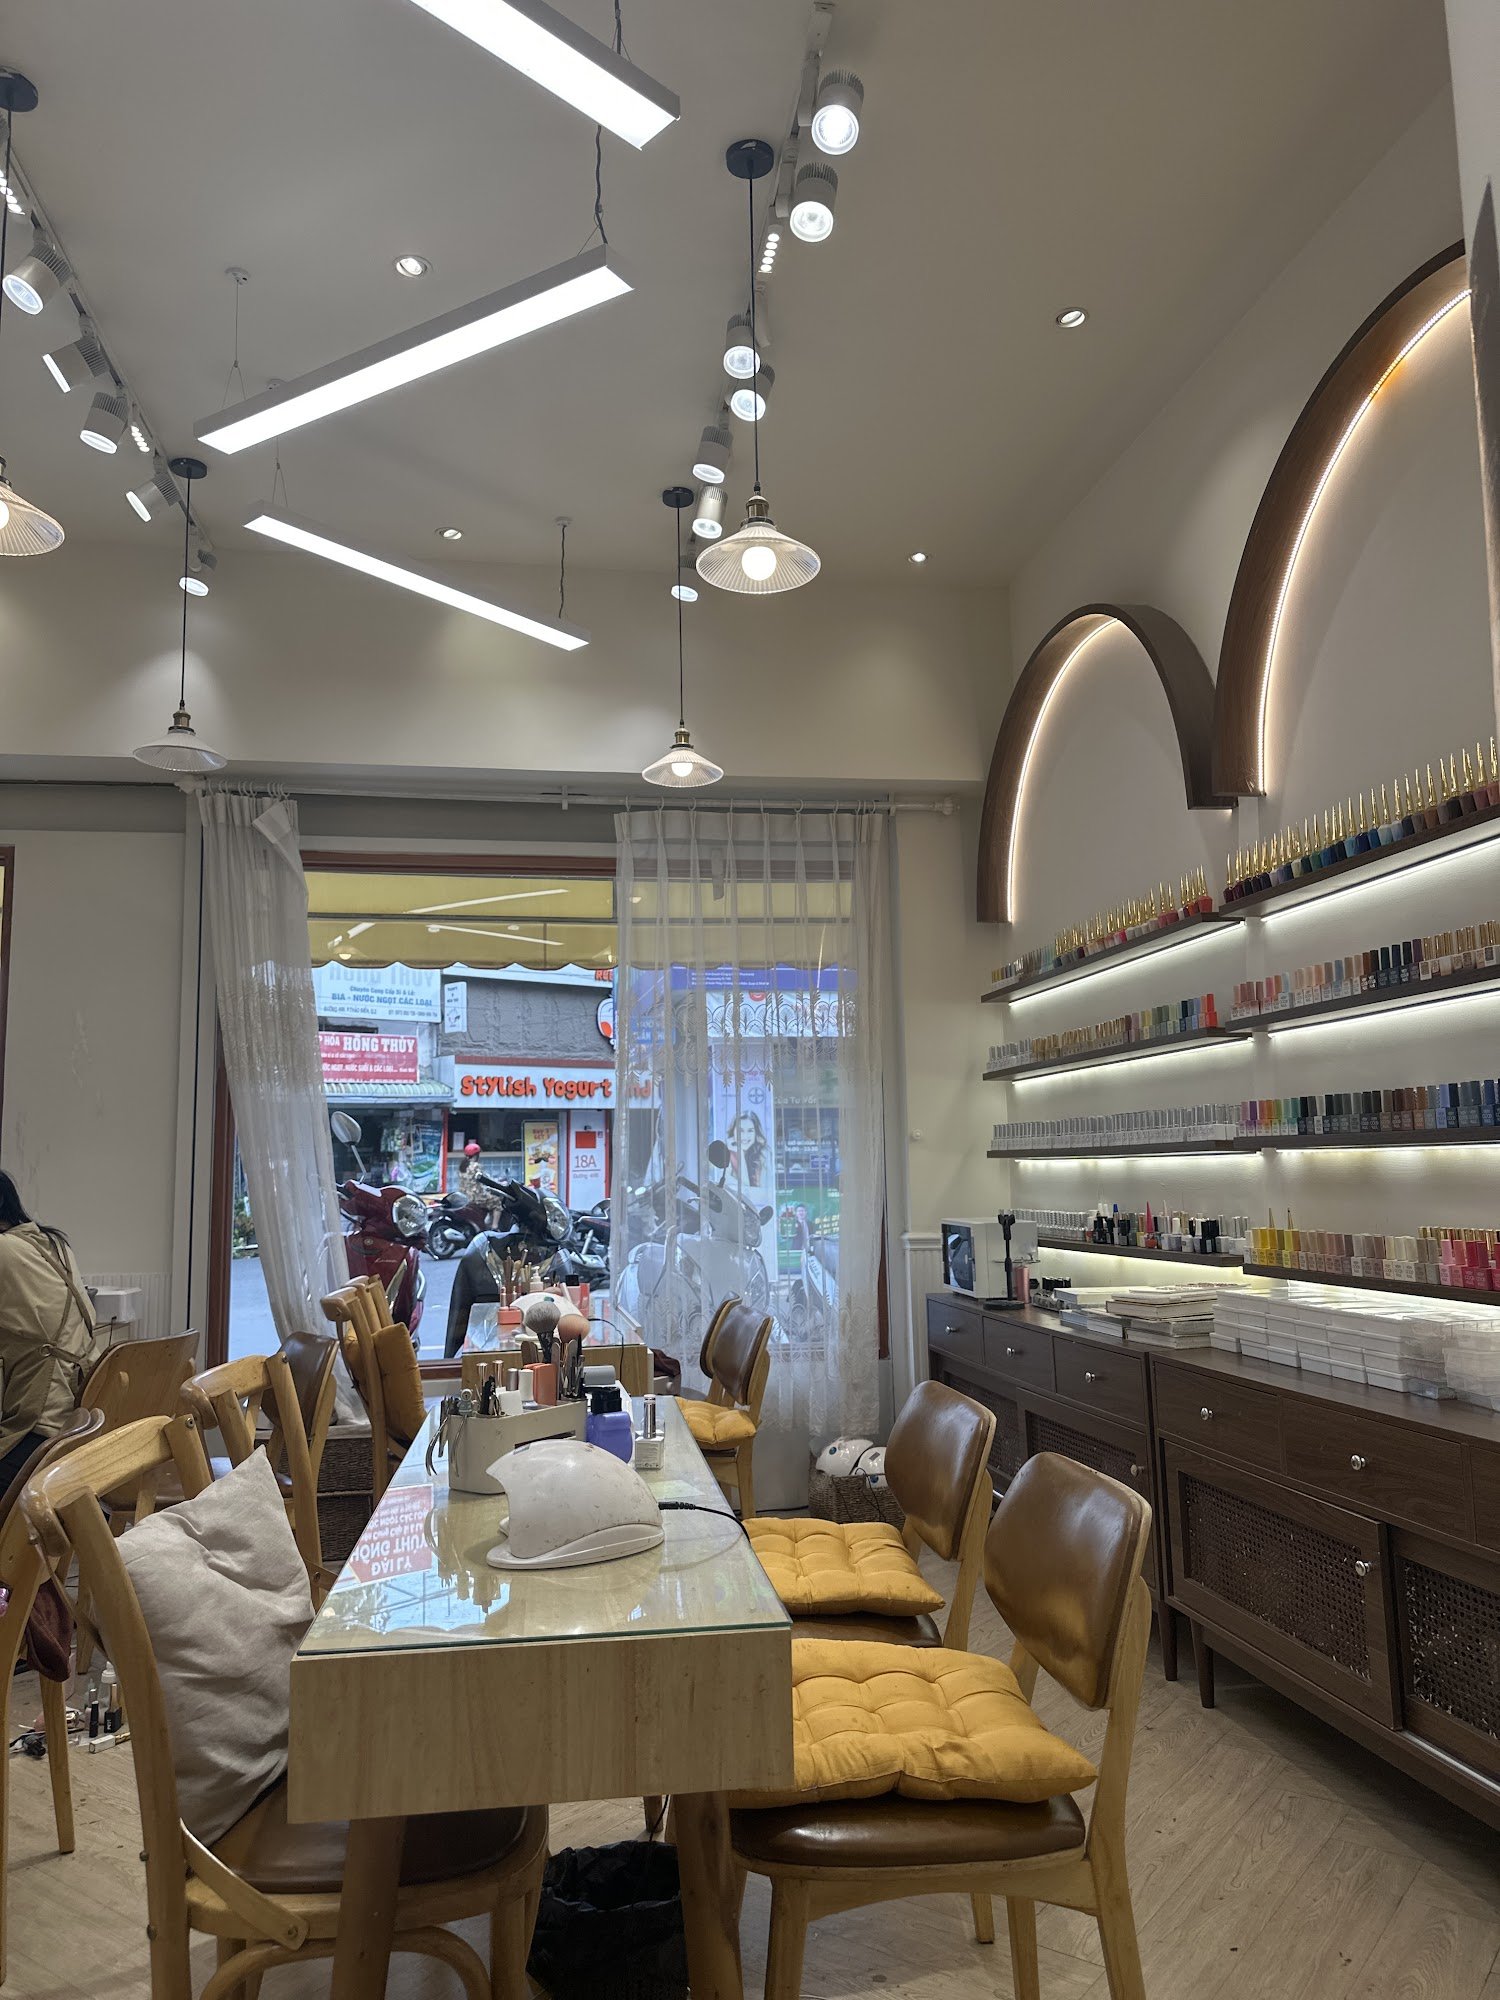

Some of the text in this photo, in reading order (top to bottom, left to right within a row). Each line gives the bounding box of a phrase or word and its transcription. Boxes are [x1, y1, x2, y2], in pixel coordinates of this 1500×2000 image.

[332, 993, 346, 1001] BIA
[377, 996, 397, 1006] NGỌT
[399, 996, 414, 1005] CÁC
[416, 998, 433, 1008] LOẠI
[460, 1075, 537, 1098] Stylish
[543, 1077, 612, 1102] Yogurt
[574, 1155, 597, 1169] 18A
